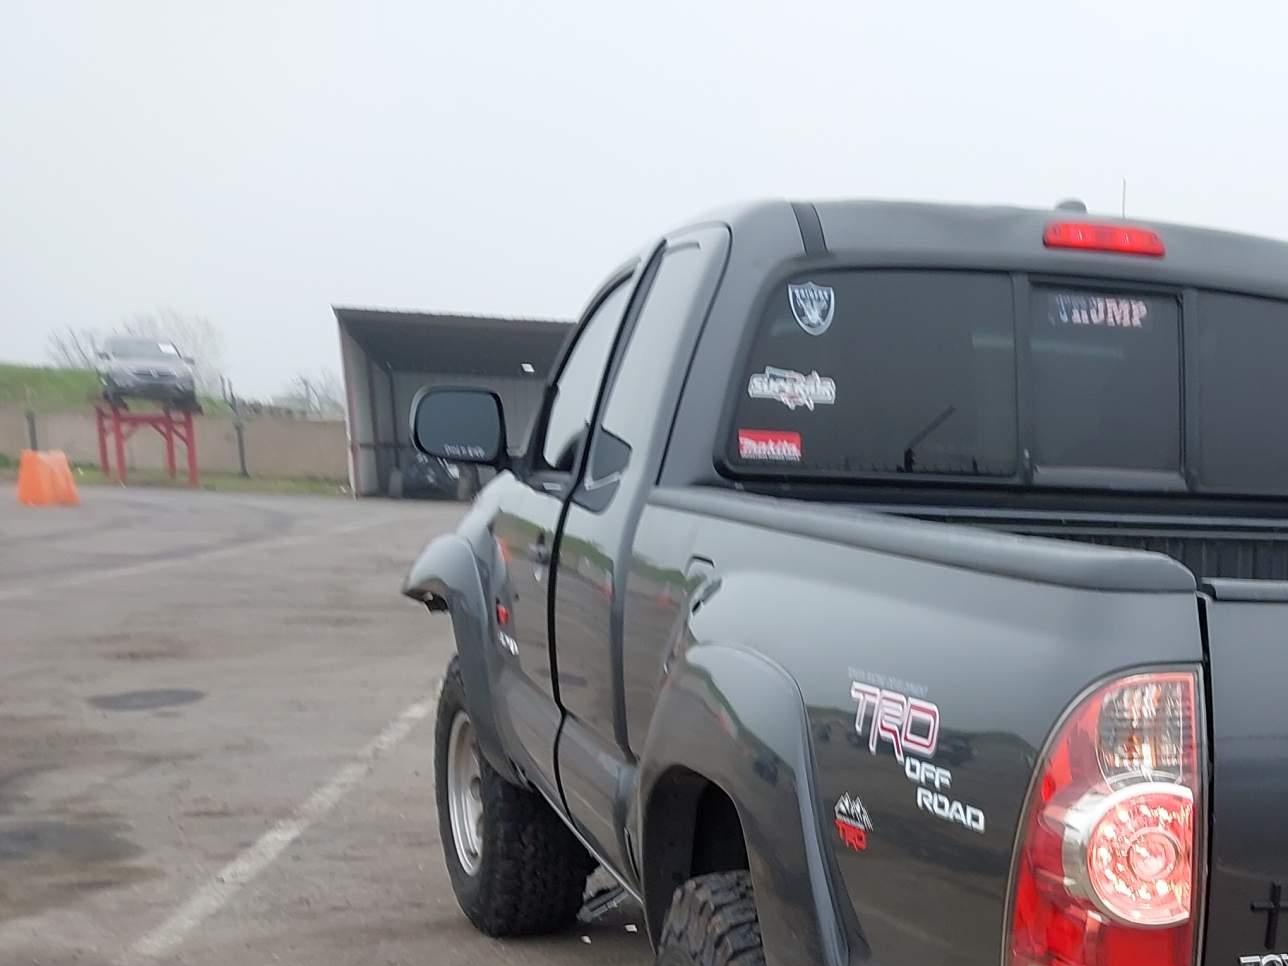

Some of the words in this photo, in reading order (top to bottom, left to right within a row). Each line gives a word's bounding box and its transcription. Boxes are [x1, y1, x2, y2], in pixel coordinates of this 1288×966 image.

[850, 680, 940, 763] TRD
[904, 756, 952, 789] OFF
[916, 787, 986, 833] ROAD
